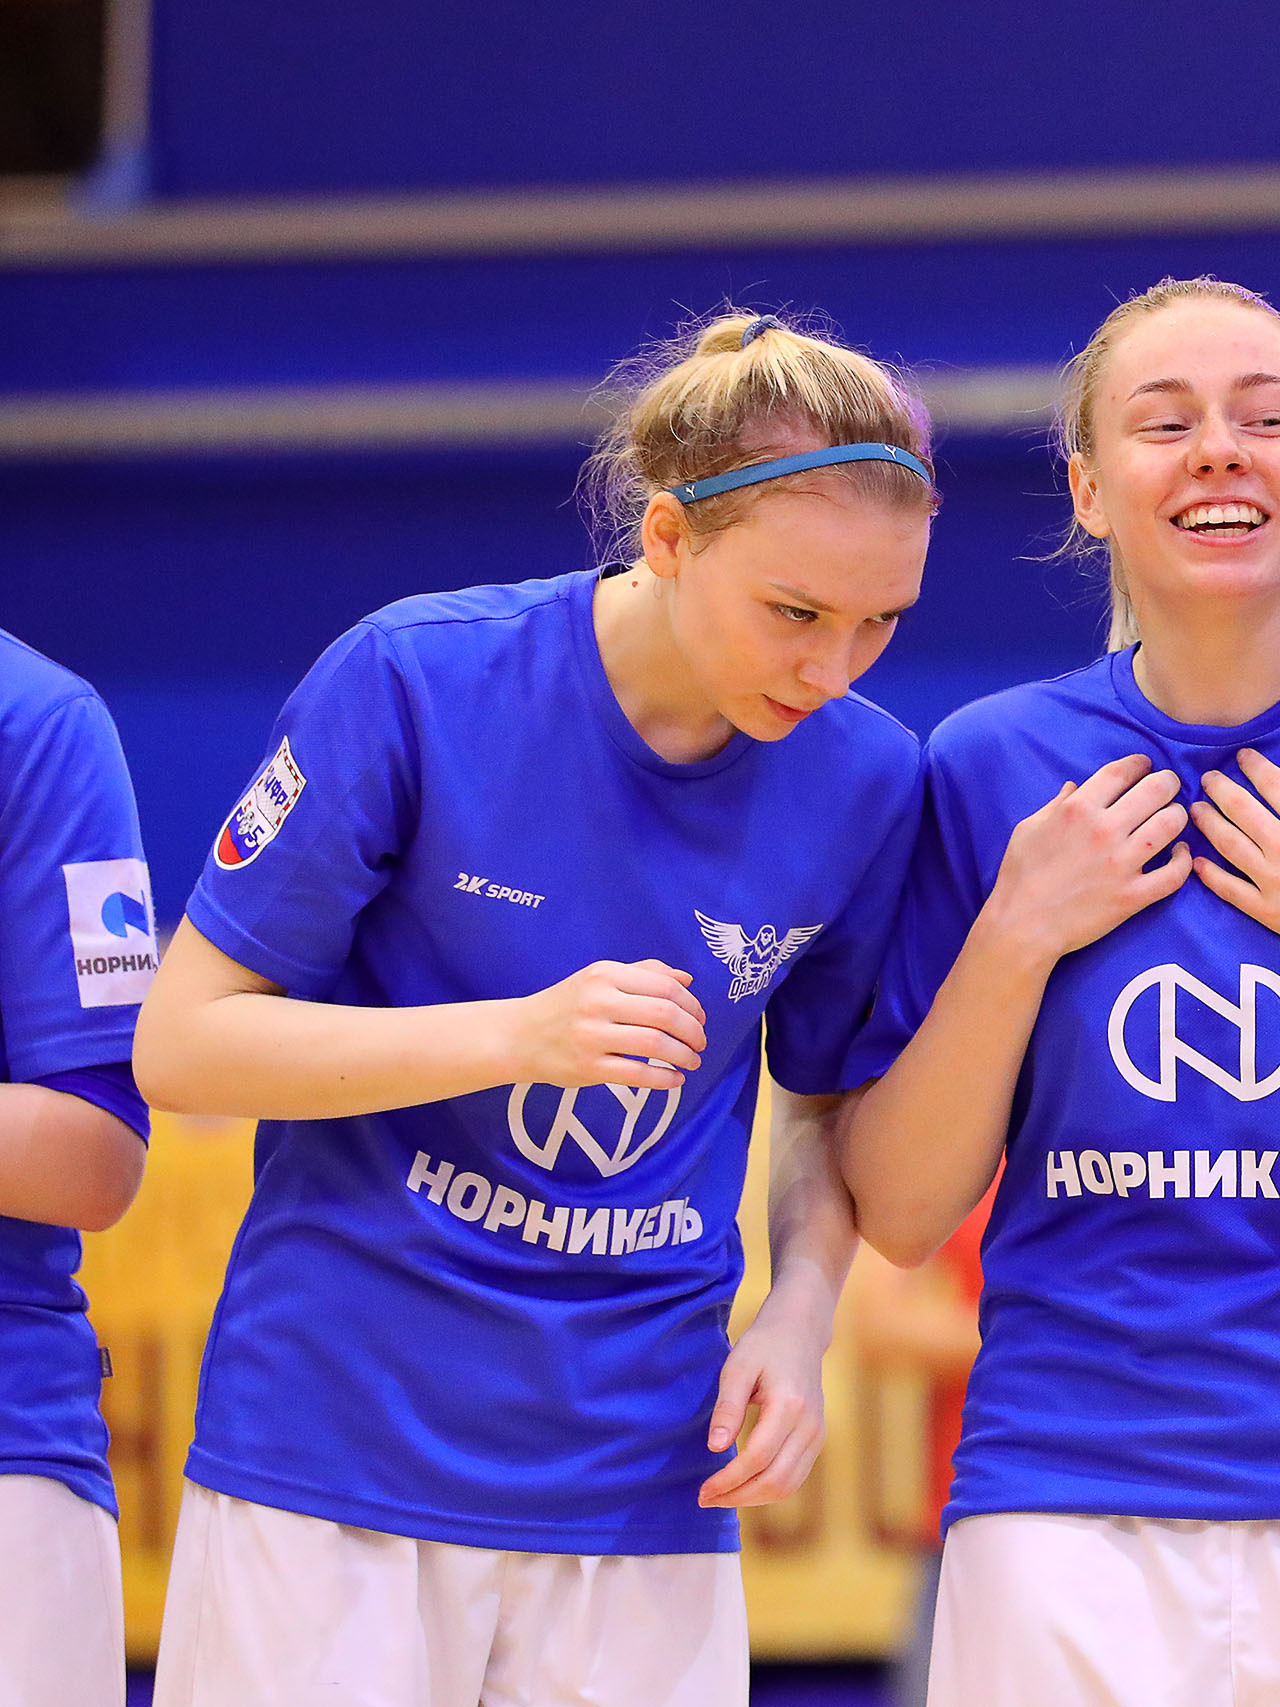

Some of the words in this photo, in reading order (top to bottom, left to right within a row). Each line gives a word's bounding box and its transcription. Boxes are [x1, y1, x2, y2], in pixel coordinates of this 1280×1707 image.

[453, 872, 489, 896] 2K
[485, 884, 546, 909] SPORT
[407, 1151, 704, 1256] НОРНИКЕЛЬ
